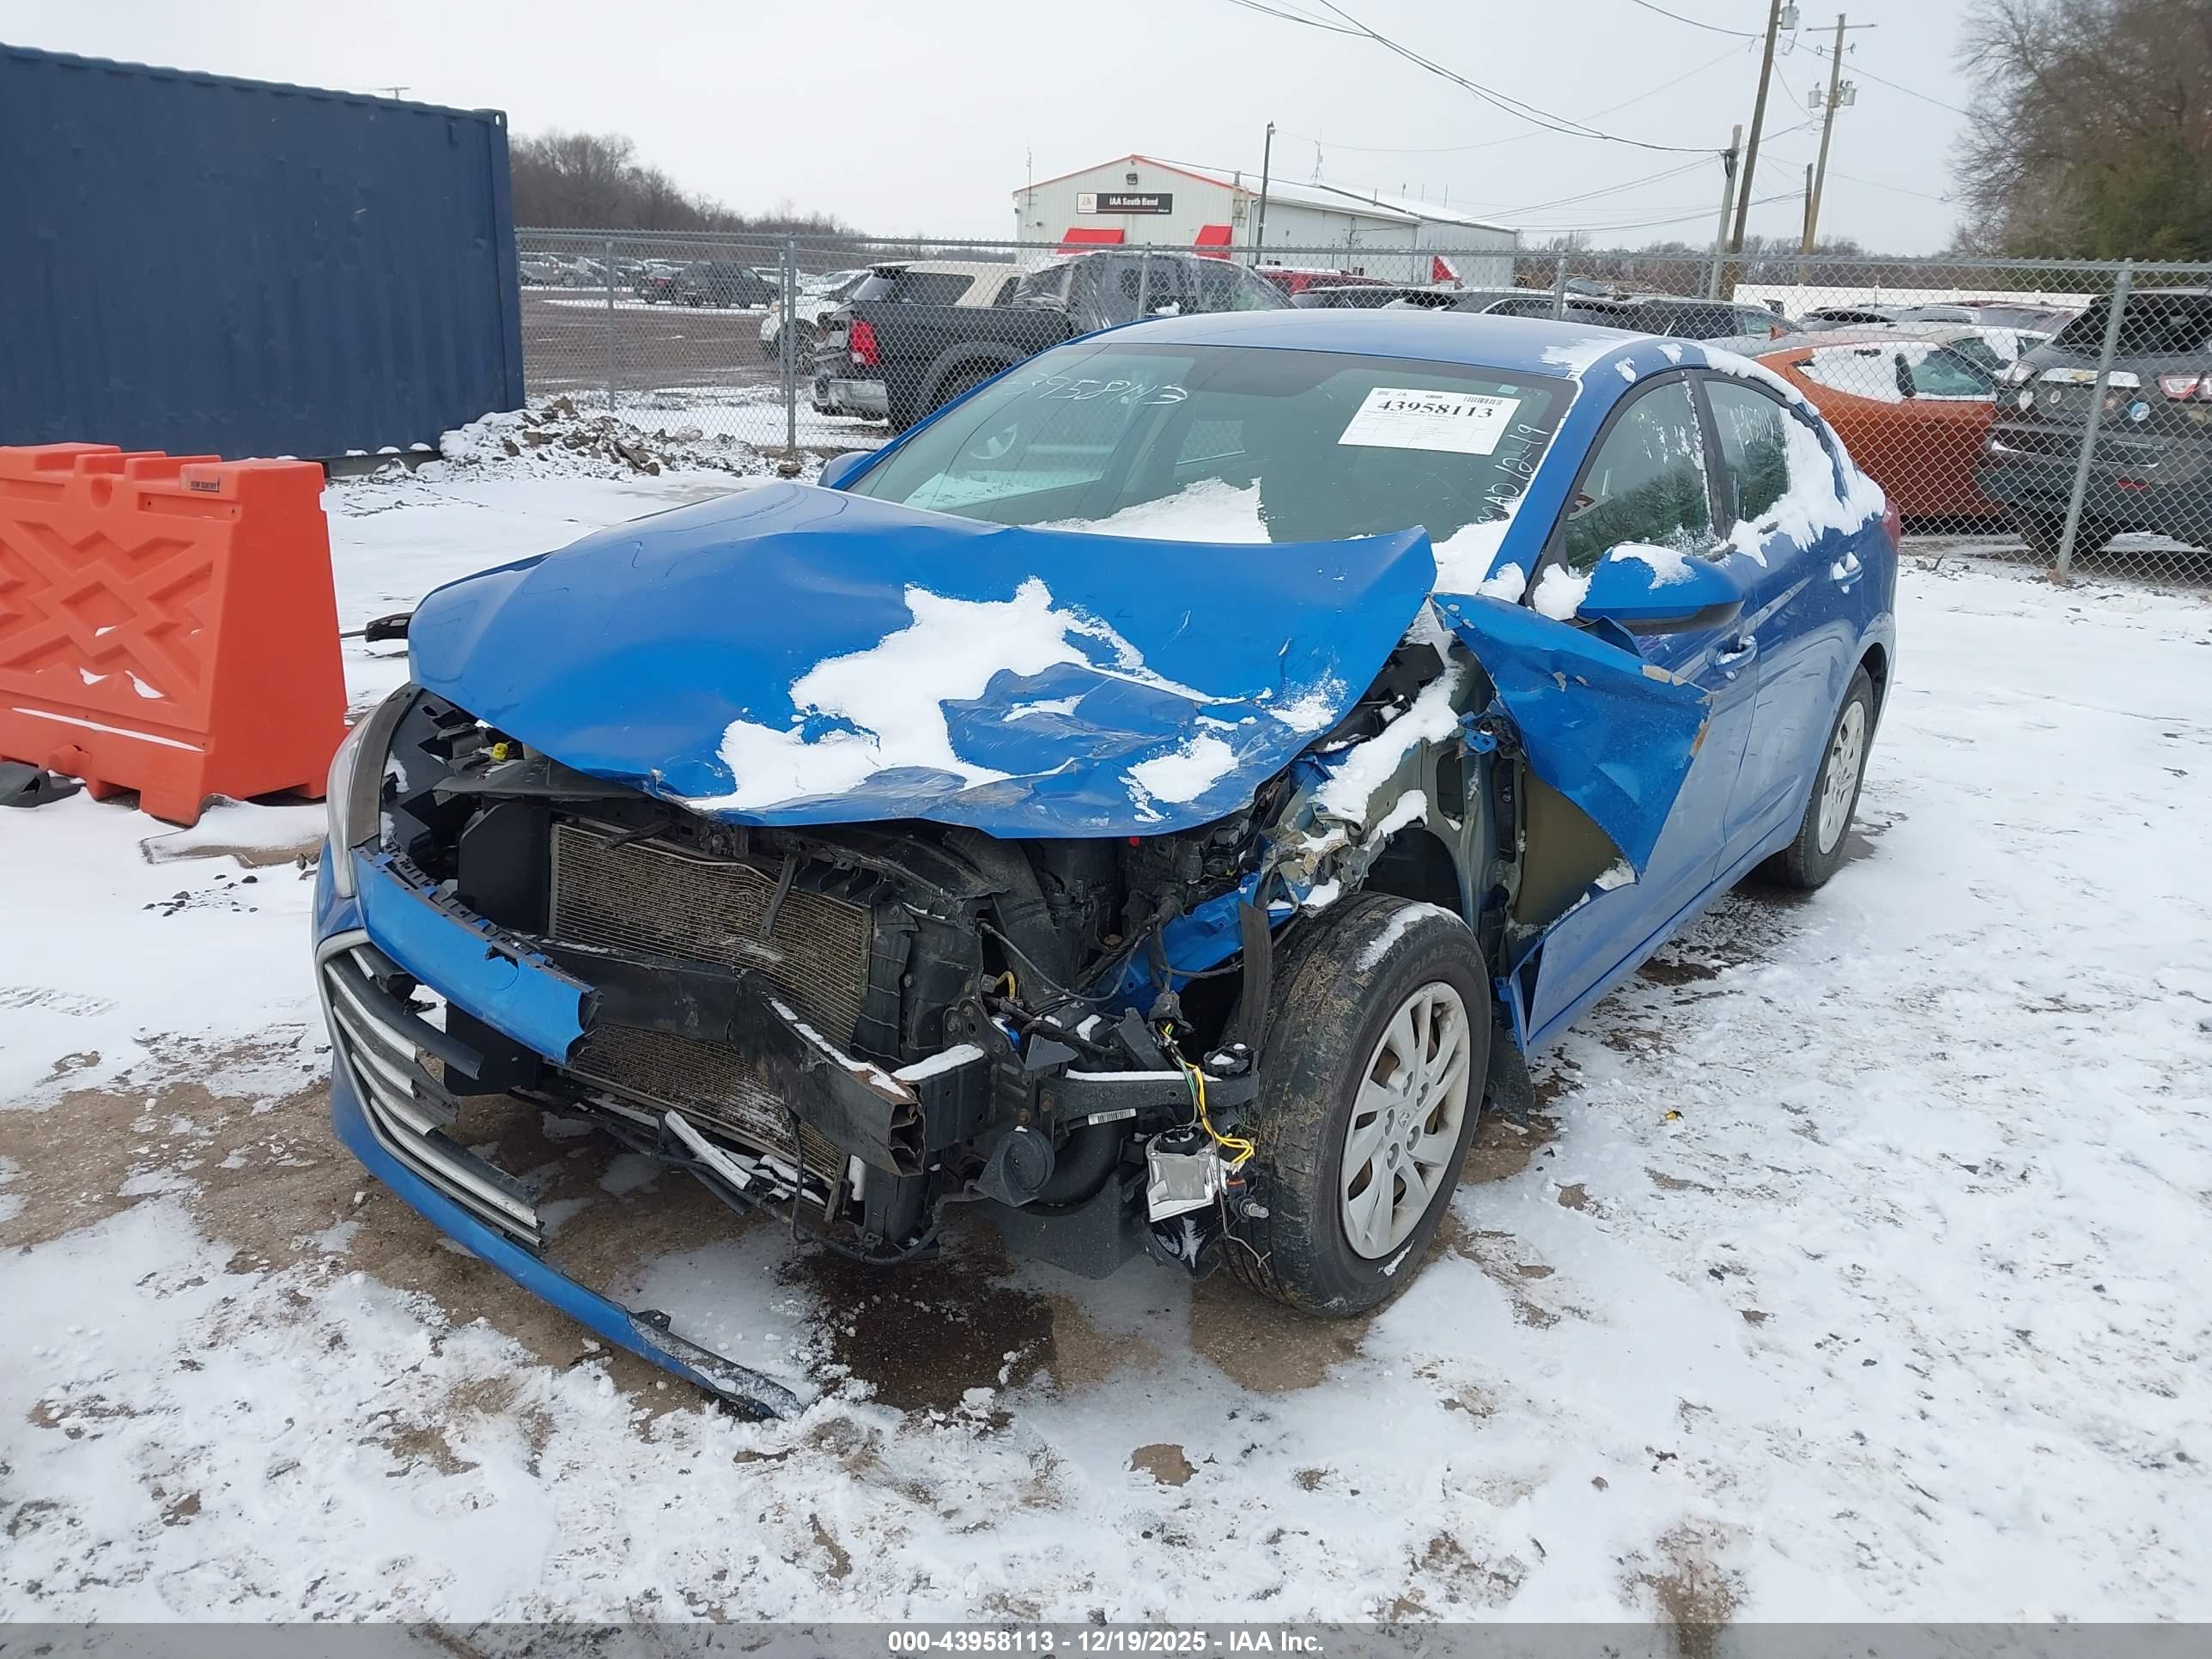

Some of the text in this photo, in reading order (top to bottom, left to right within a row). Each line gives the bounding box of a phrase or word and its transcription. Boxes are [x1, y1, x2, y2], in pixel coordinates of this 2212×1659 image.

[1109, 197, 1158, 206] IAA South Bend
[1376, 399, 1494, 418] 43958113
[1493, 422, 1551, 481] 12-19
